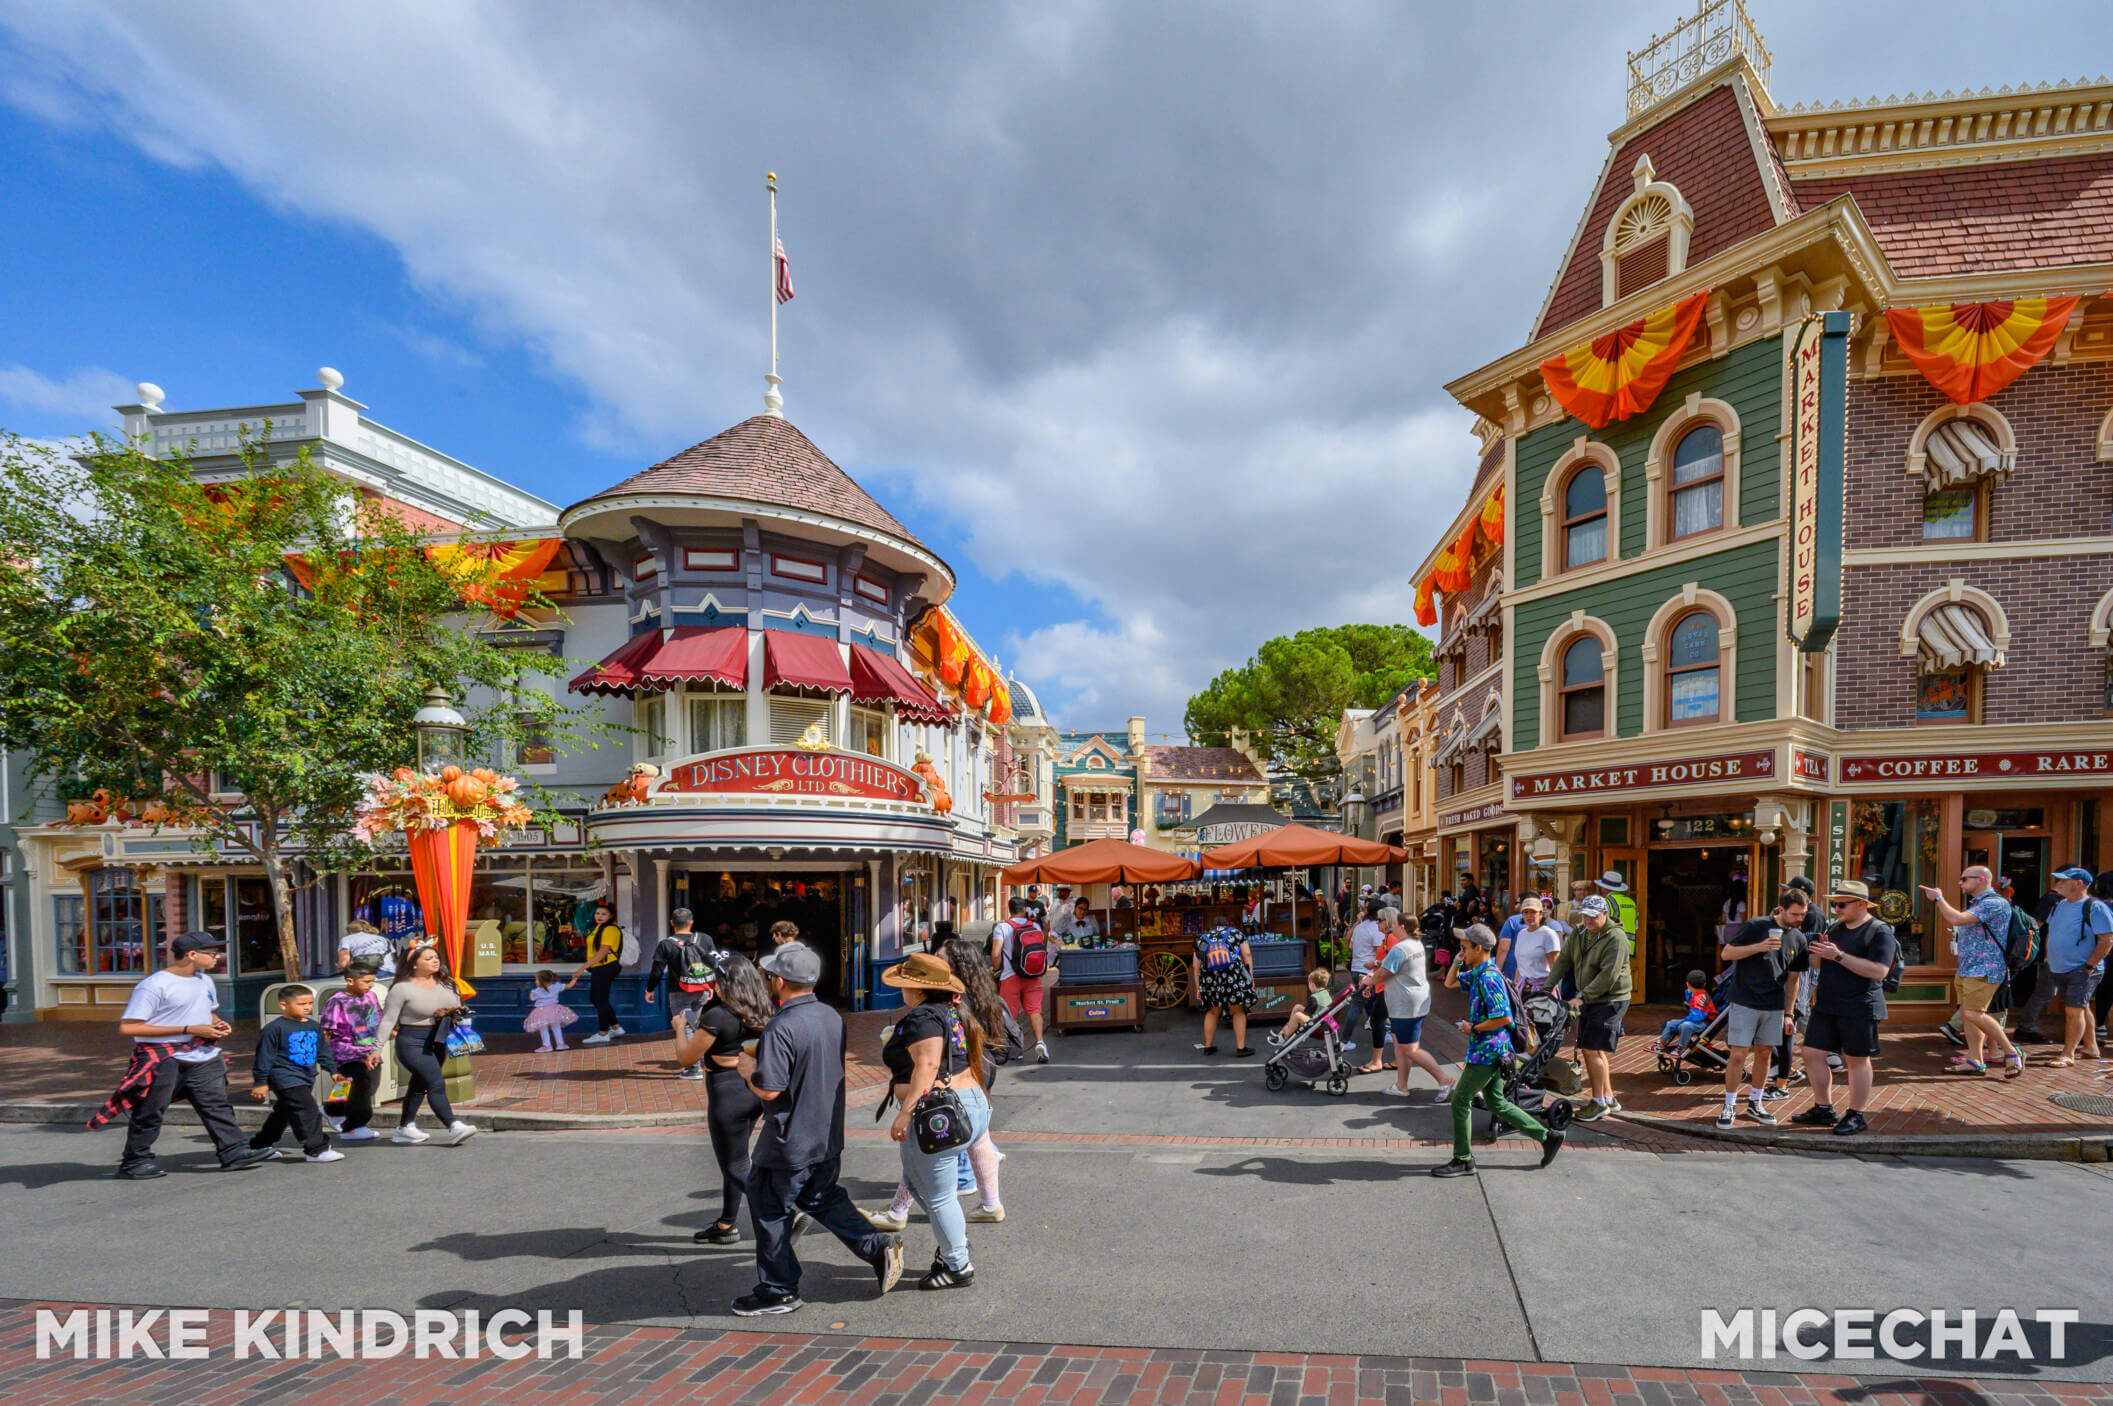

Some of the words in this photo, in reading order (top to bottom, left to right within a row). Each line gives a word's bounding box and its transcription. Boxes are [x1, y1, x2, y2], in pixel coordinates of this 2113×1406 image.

[1800, 335, 1818, 486] MARKET
[1796, 496, 1813, 619] HOUSE
[1803, 758, 1819, 775] TEA
[1877, 758, 1979, 777] COFFEE
[2037, 754, 2108, 771] RARE
[691, 754, 787, 788] DISNEY
[791, 756, 909, 797] CLOTHIERS
[1533, 770, 1638, 793] MARKET
[1651, 759, 1742, 783] HOUSE
[798, 779, 826, 793] LTD
[1463, 808, 1481, 822] BAKED
[1205, 823, 1279, 842] FLOWER
[1686, 819, 1715, 833] 122
[517, 831, 539, 841] 1905
